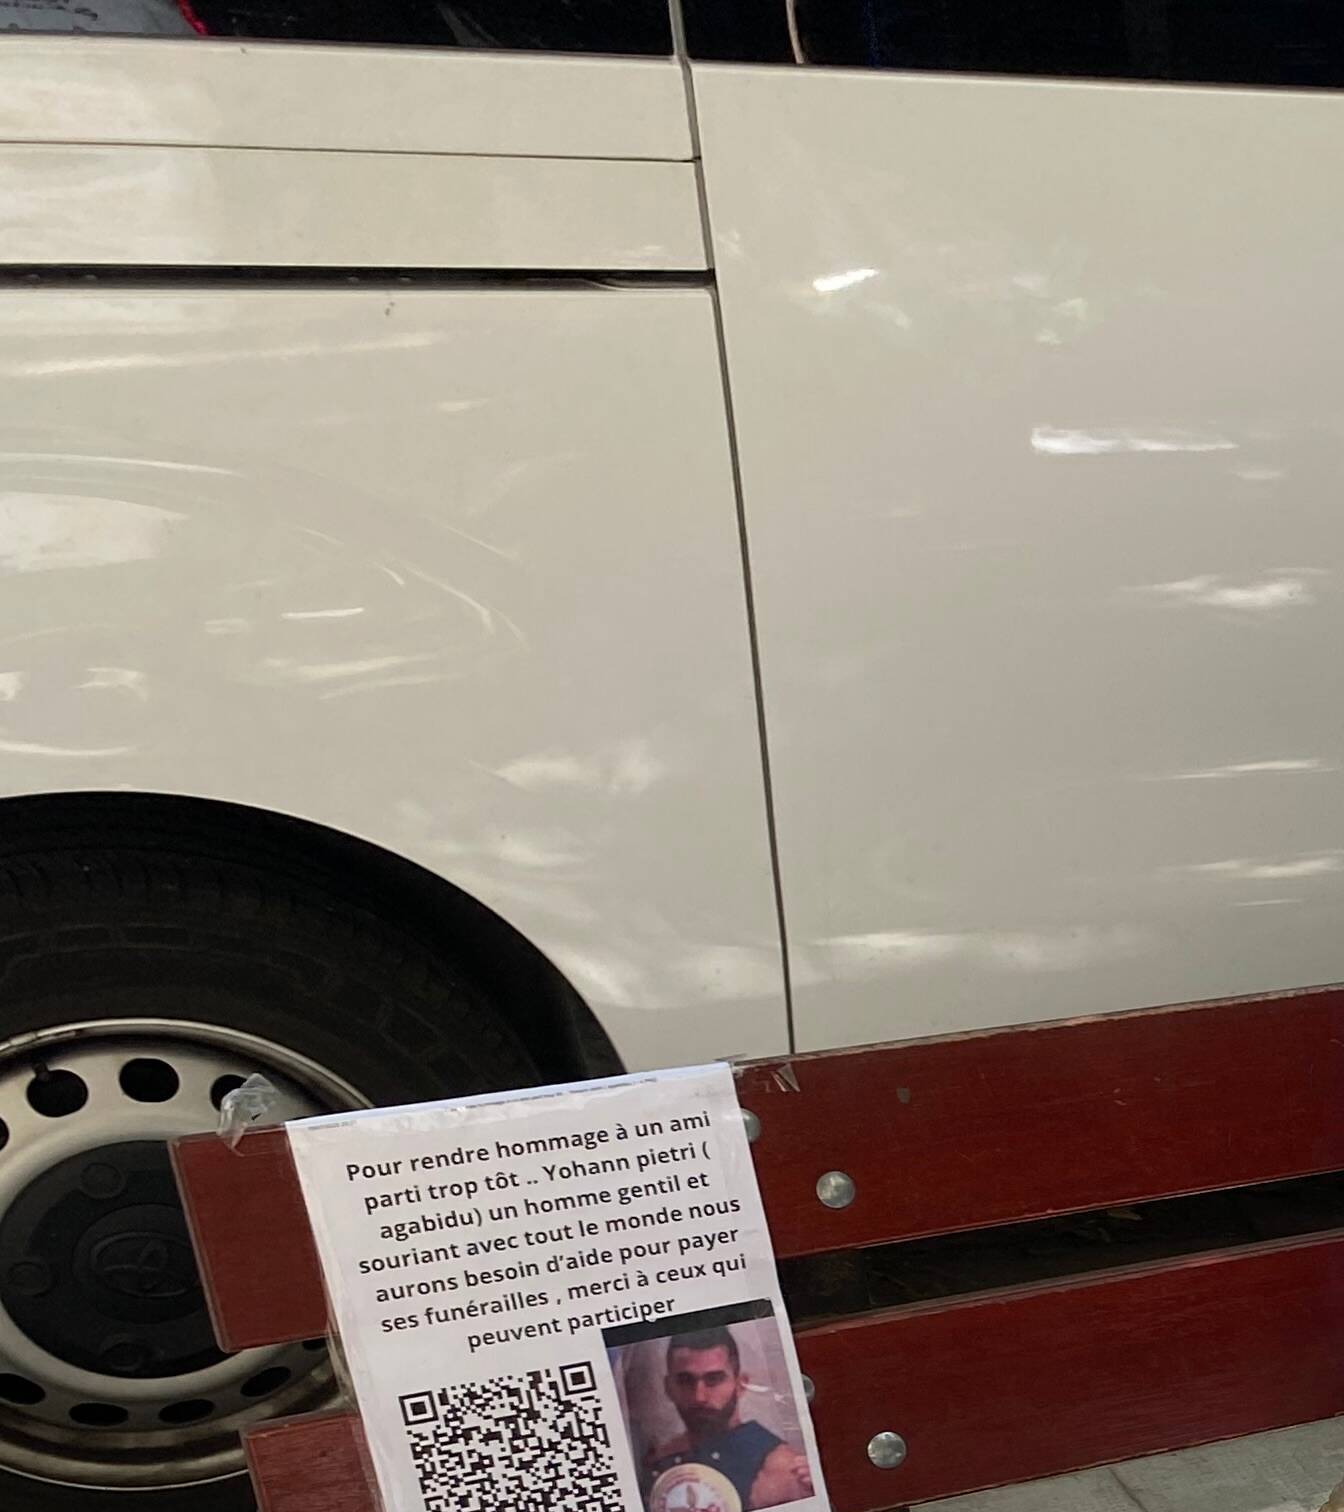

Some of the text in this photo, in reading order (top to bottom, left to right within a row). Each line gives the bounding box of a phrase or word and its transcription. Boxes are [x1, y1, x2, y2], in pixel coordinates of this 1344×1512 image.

[345, 1110, 711, 1182] Pour rendre hommage à un ami
[363, 1184, 423, 1216] parti
[427, 1180, 479, 1201] trop
[483, 1171, 521, 1191] tôt
[541, 1157, 631, 1182] Yohann
[635, 1141, 697, 1173] pietri
[358, 1199, 741, 1275] souriant avec tout le monde nous
[379, 1172, 711, 1243] agabidu) un homme gentil et
[375, 1228, 739, 1303] aurons besoin d'aide pour payer
[380, 1314, 420, 1333] ses
[423, 1291, 550, 1326] funérailles
[567, 1272, 631, 1301] merci
[635, 1269, 650, 1288] à
[655, 1263, 708, 1285] ceux
[711, 1252, 747, 1278] qui
[467, 1297, 675, 1353] peuvent participer
